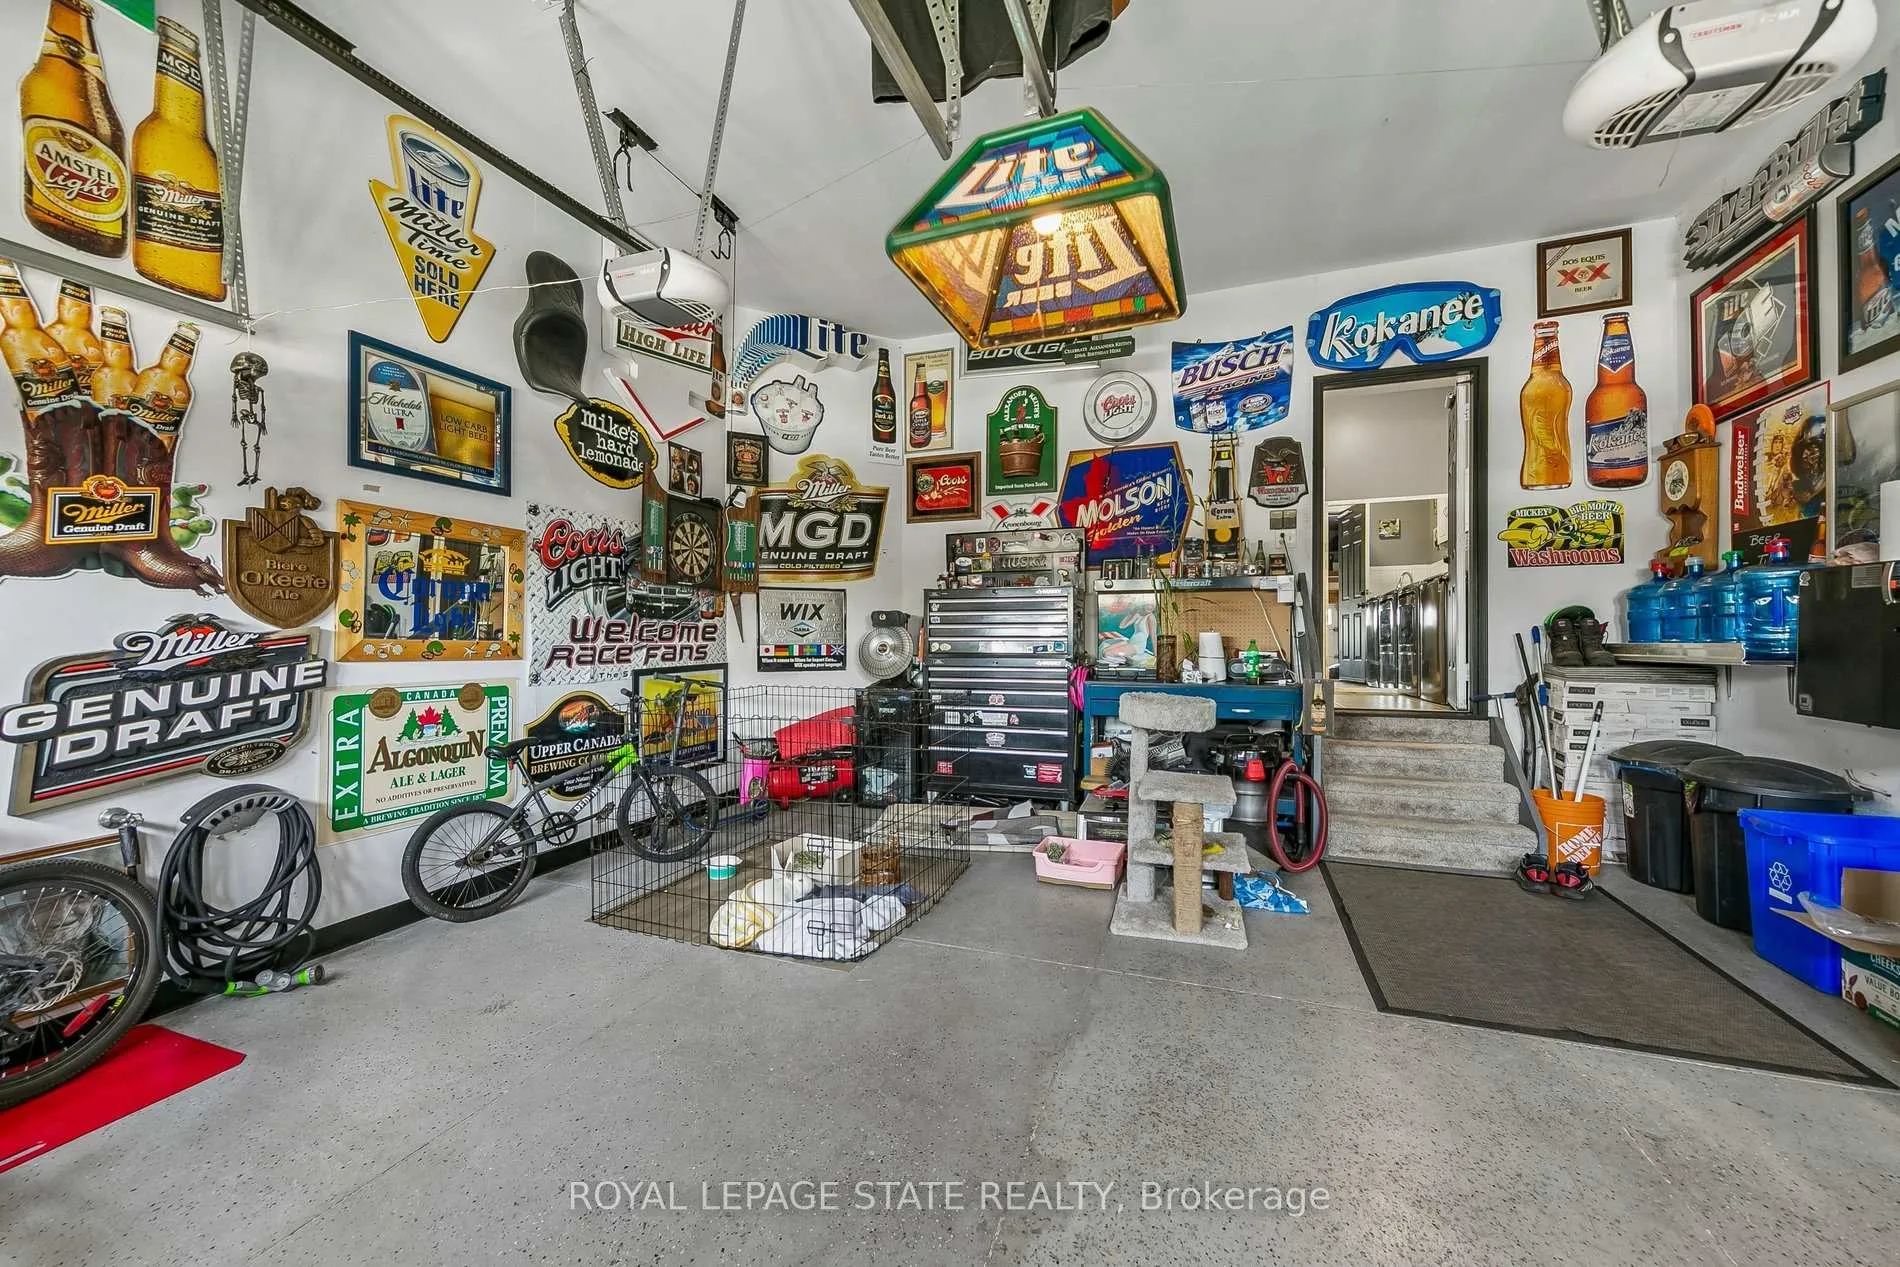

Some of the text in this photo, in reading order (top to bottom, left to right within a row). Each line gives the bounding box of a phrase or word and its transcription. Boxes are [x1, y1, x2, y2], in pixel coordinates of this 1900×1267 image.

[161, 51, 202, 83] MGD
[40, 144, 115, 186] AMSTEL
[934, 141, 1097, 211] Lite
[153, 184, 205, 206] Miller
[408, 164, 465, 220] Lite
[138, 206, 185, 222] GENUINE
[388, 196, 482, 256] Miller
[400, 221, 471, 270] Time
[414, 254, 459, 289] SOLD
[1562, 254, 1605, 266] DOS EQUIS
[414, 274, 460, 310] HERE
[798, 314, 868, 359] Lite
[1318, 293, 1485, 361] Kokanee
[623, 325, 666, 352] HIGH
[672, 343, 706, 365] LIFE
[968, 348, 1013, 361] BUD
[1600, 344, 1631, 359] Kokanee
[1178, 342, 1287, 389] BUSCH
[21, 377, 74, 398] Miller
[1206, 370, 1278, 395] RACING
[27, 397, 59, 407] Genuine
[129, 403, 180, 423] Miller
[368, 392, 422, 411] Michelob
[383, 407, 415, 418] ULTRA
[1004, 390, 1027, 422] ALEXANDER
[1101, 394, 1136, 410] Coors
[1104, 405, 1134, 420] LIGHT
[439, 424, 466, 437] LIGHT
[468, 431, 489, 441] BEER
[440, 414, 488, 433] LOW CARB
[581, 408, 639, 445] mike's
[596, 433, 634, 457] hard
[1588, 425, 1648, 455] Kokanee
[578, 441, 644, 472] lemonade
[940, 474, 967, 486] Coors
[1734, 430, 1745, 512] Budweiser
[797, 479, 851, 499] Miller
[1077, 472, 1173, 528] MOLSON
[63, 501, 145, 525] Miller
[1211, 507, 1236, 517] Corona
[1569, 502, 1621, 516] BIG MOUTH
[1580, 512, 1611, 520] BEER
[63, 522, 145, 533] Genuine Draft
[532, 519, 627, 569] Coors
[1510, 547, 1621, 567] Washrooms
[547, 556, 625, 597] LIGHT
[271, 589, 301, 600] Ale
[780, 603, 825, 620] WIX
[569, 613, 719, 644] Welcome
[122, 631, 259, 672] Miller
[545, 643, 709, 670] Race Fans
[2, 660, 327, 737] GENUINE
[406, 690, 456, 701] CANADA
[53, 694, 292, 765] DRAFT
[366, 729, 486, 775] ALGONQUIN
[530, 734, 622, 760] UPPER CANADA
[335, 708, 360, 821] EXTRA
[531, 757, 577, 776] BREWING
[390, 766, 466, 789] ALE & LAGER
[375, 796, 386, 804] NO
[388, 790, 422, 802] ADDITIVES
[433, 780, 477, 793] PRESERVATIVES
[371, 809, 408, 824] BREWING
[410, 802, 450, 815] TRADITION
[451, 797, 471, 807] SINCE
[1864, 975, 1900, 1000] VALUE BO
